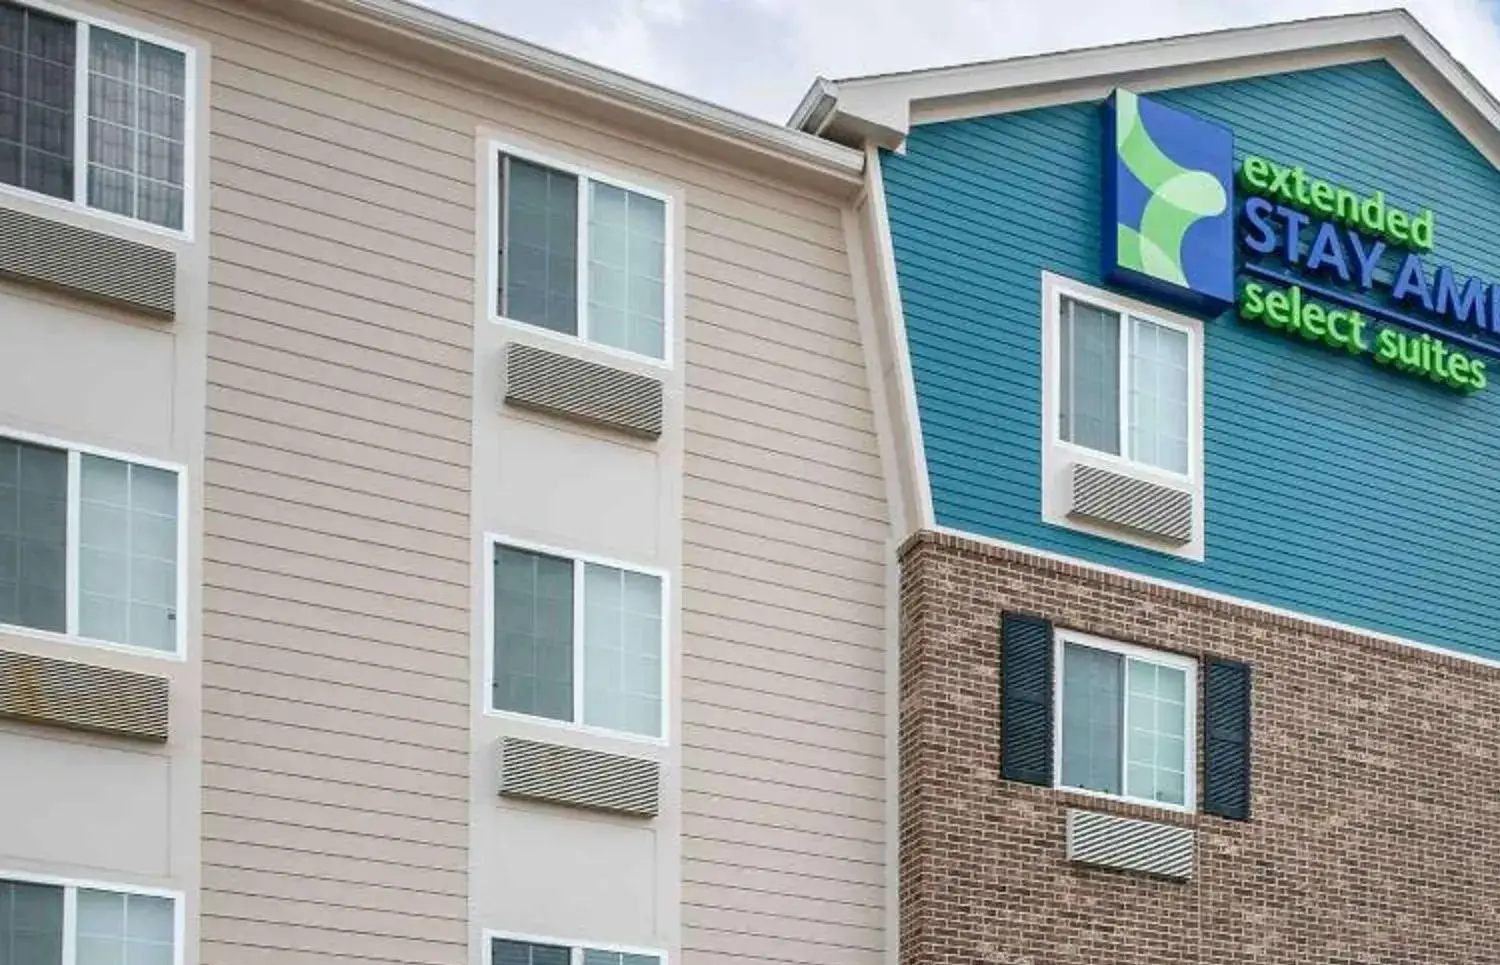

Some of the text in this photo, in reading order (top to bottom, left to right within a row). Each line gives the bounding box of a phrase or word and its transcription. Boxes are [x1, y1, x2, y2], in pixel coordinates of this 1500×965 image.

[1242, 154, 1434, 250] extended
[1244, 196, 1387, 289] STAY
[1242, 282, 1488, 390] select suites
